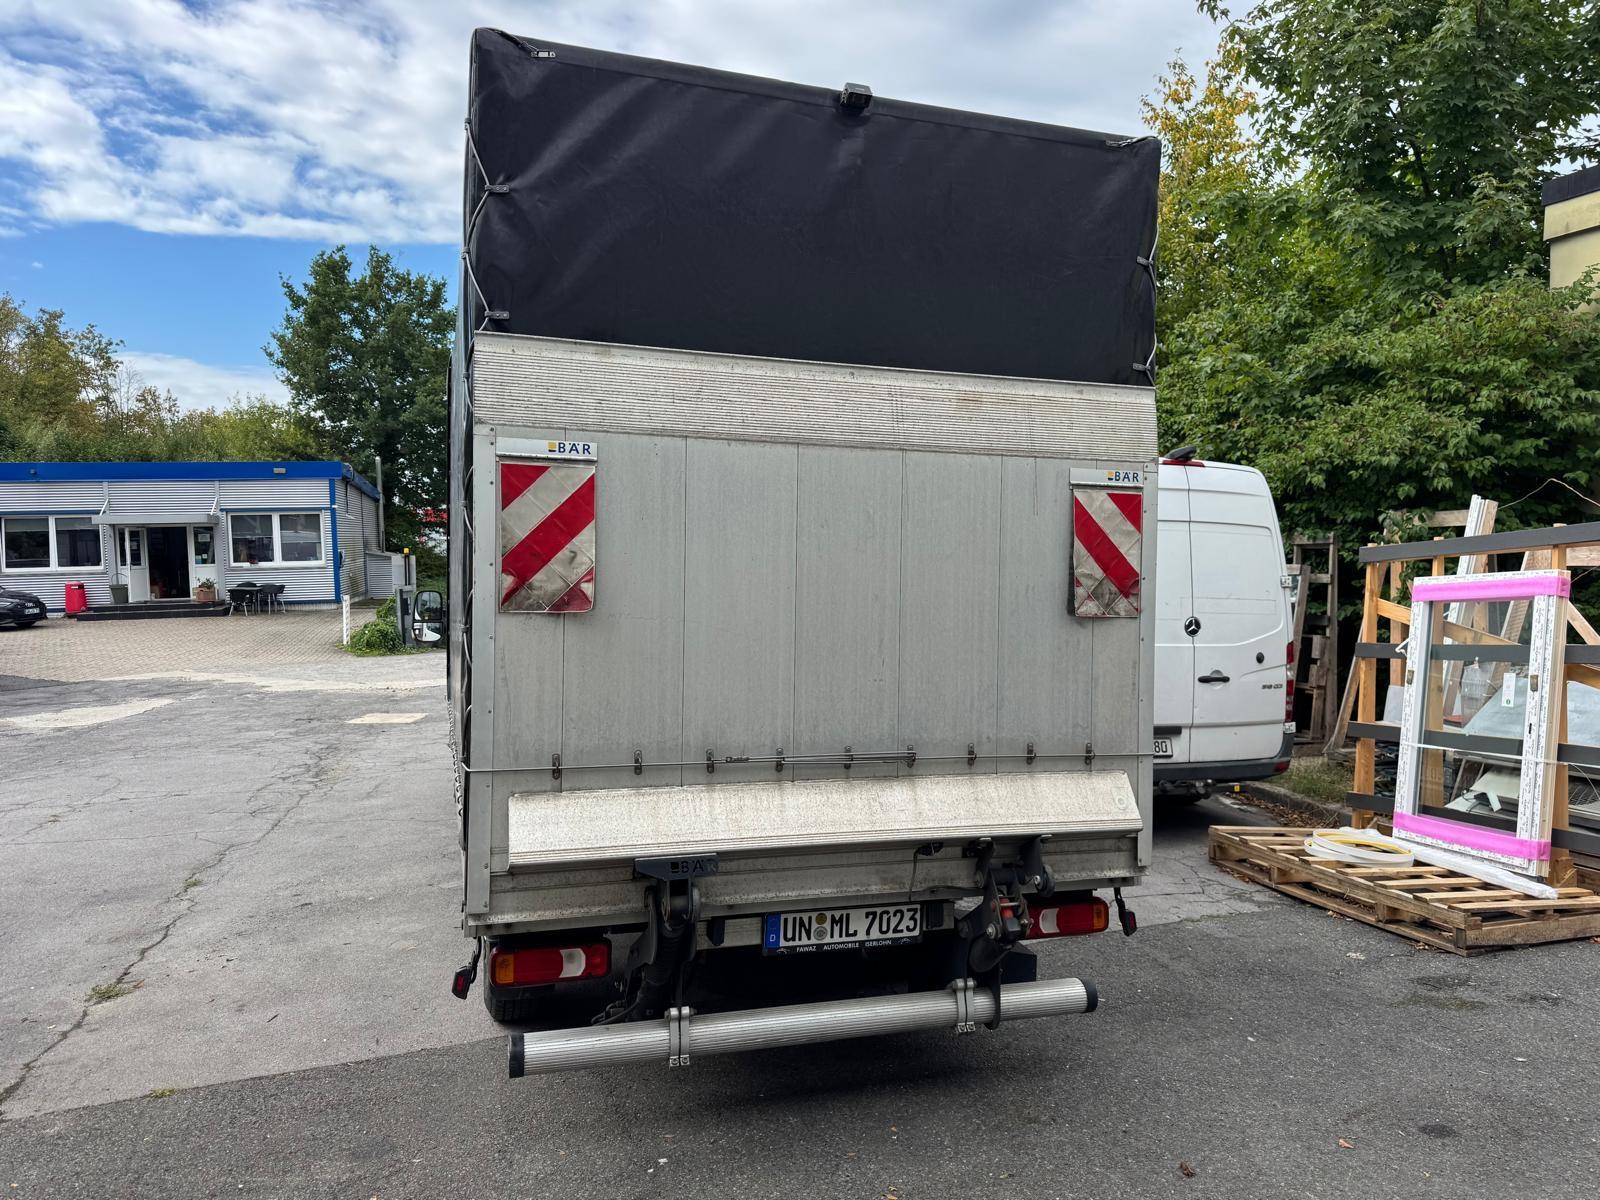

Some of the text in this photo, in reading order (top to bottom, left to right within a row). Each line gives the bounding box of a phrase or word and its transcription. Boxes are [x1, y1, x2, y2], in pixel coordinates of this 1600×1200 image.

[558, 442, 591, 454] BÄR
[1114, 471, 1139, 482] BÄR
[783, 907, 919, 942] UN ML 7023
[796, 939, 892, 953] FAWAZ AUTOMOBILE ISERLOHN
